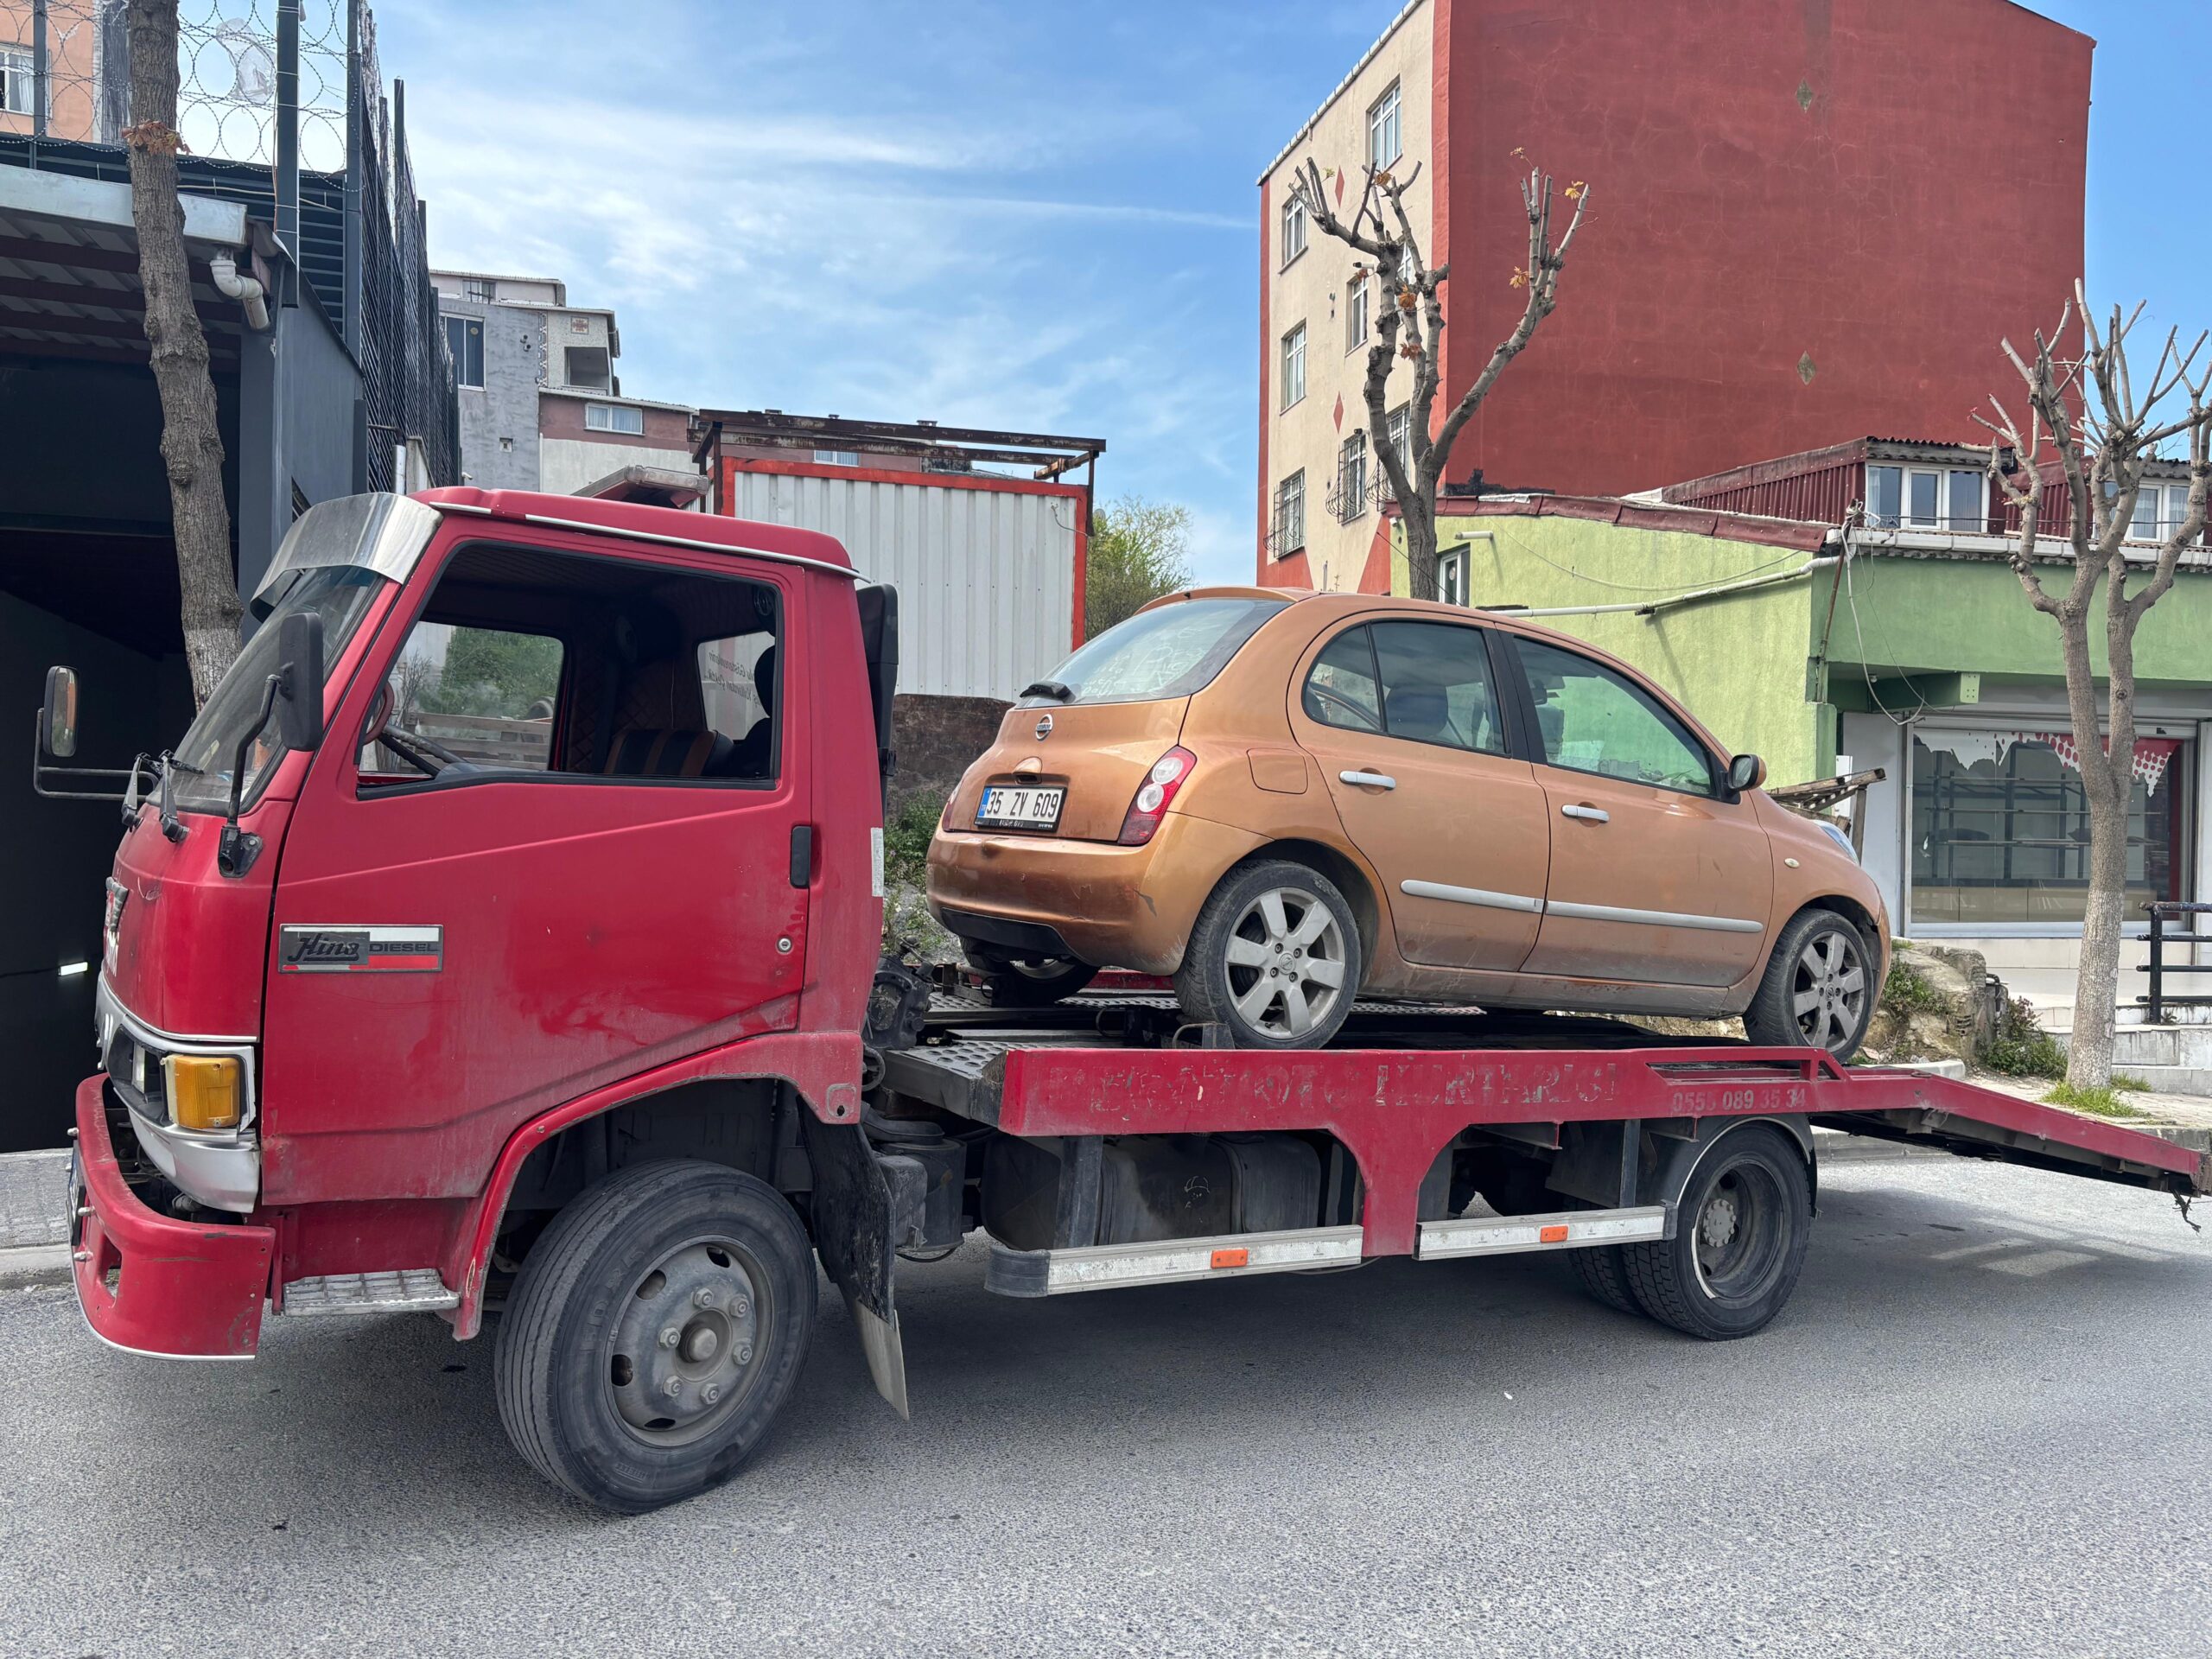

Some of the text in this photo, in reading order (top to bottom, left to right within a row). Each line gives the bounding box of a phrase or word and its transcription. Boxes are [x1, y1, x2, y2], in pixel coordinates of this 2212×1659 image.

[987, 791, 1059, 818] 35 ZY 609
[288, 932, 439, 962] Hino DIESEL
[1722, 1090, 1754, 1111] 089
